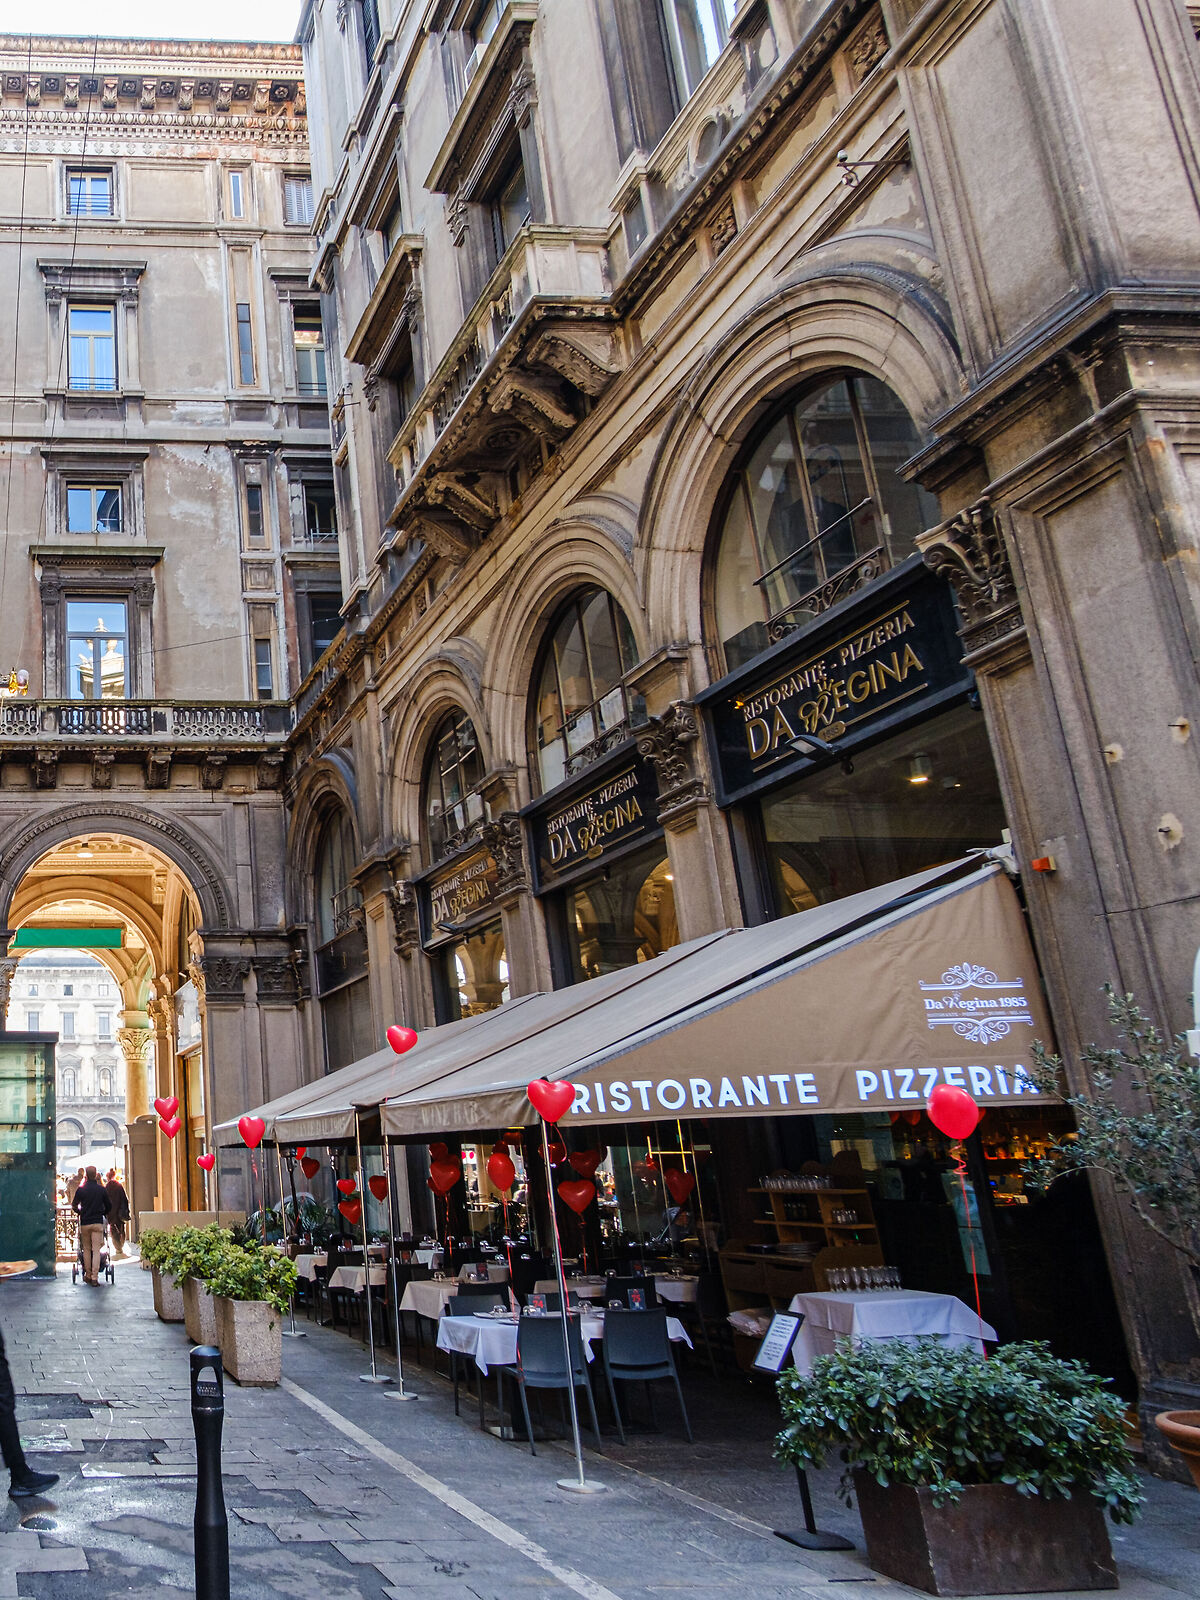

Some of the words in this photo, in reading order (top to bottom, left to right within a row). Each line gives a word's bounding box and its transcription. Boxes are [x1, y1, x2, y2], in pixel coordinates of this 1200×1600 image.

[743, 660, 827, 722] RISTORANTE
[839, 610, 916, 666] PIZZERIA
[745, 705, 796, 760] DA
[798, 643, 924, 733] REGINA
[547, 797, 594, 835] RISTORANTE
[599, 771, 639, 805] PIZZERIA
[548, 825, 577, 865] DA
[577, 795, 643, 851] REGINA
[431, 895, 450, 925] DA
[449, 877, 491, 917] REGINA
[923, 998, 944, 1010] Da
[942, 994, 999, 1011] Regina
[997, 996, 1029, 1008] 1985
[421, 1103, 450, 1127] WINE
[453, 1100, 479, 1124] BAR
[570, 1073, 820, 1115] RISTORANTE
[855, 1063, 1040, 1101] PIZZERIA
